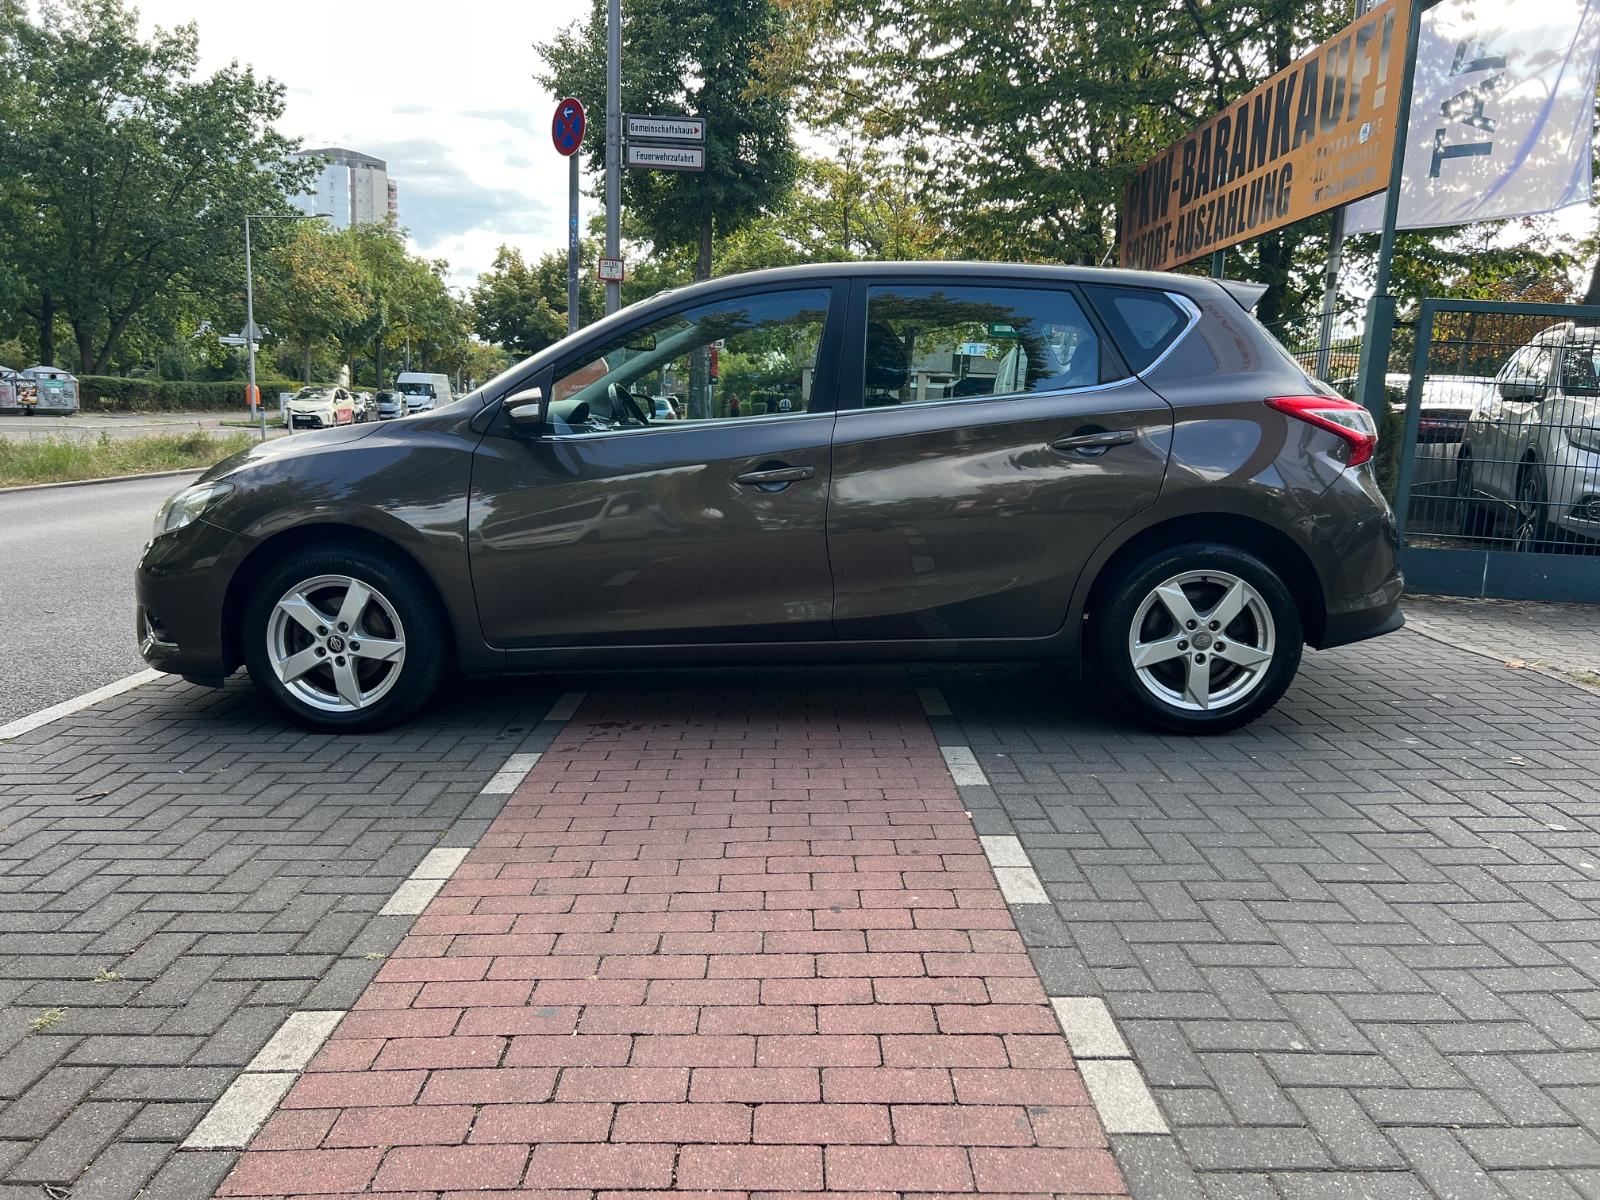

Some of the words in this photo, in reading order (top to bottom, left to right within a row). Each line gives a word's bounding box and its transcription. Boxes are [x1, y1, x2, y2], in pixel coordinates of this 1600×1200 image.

[630, 122, 694, 136] Gemeinschaftshaus
[636, 150, 695, 163] Feuerwehrzufahrt
[1125, 161, 1294, 267] SOFORT-AUSZAHLUNG
